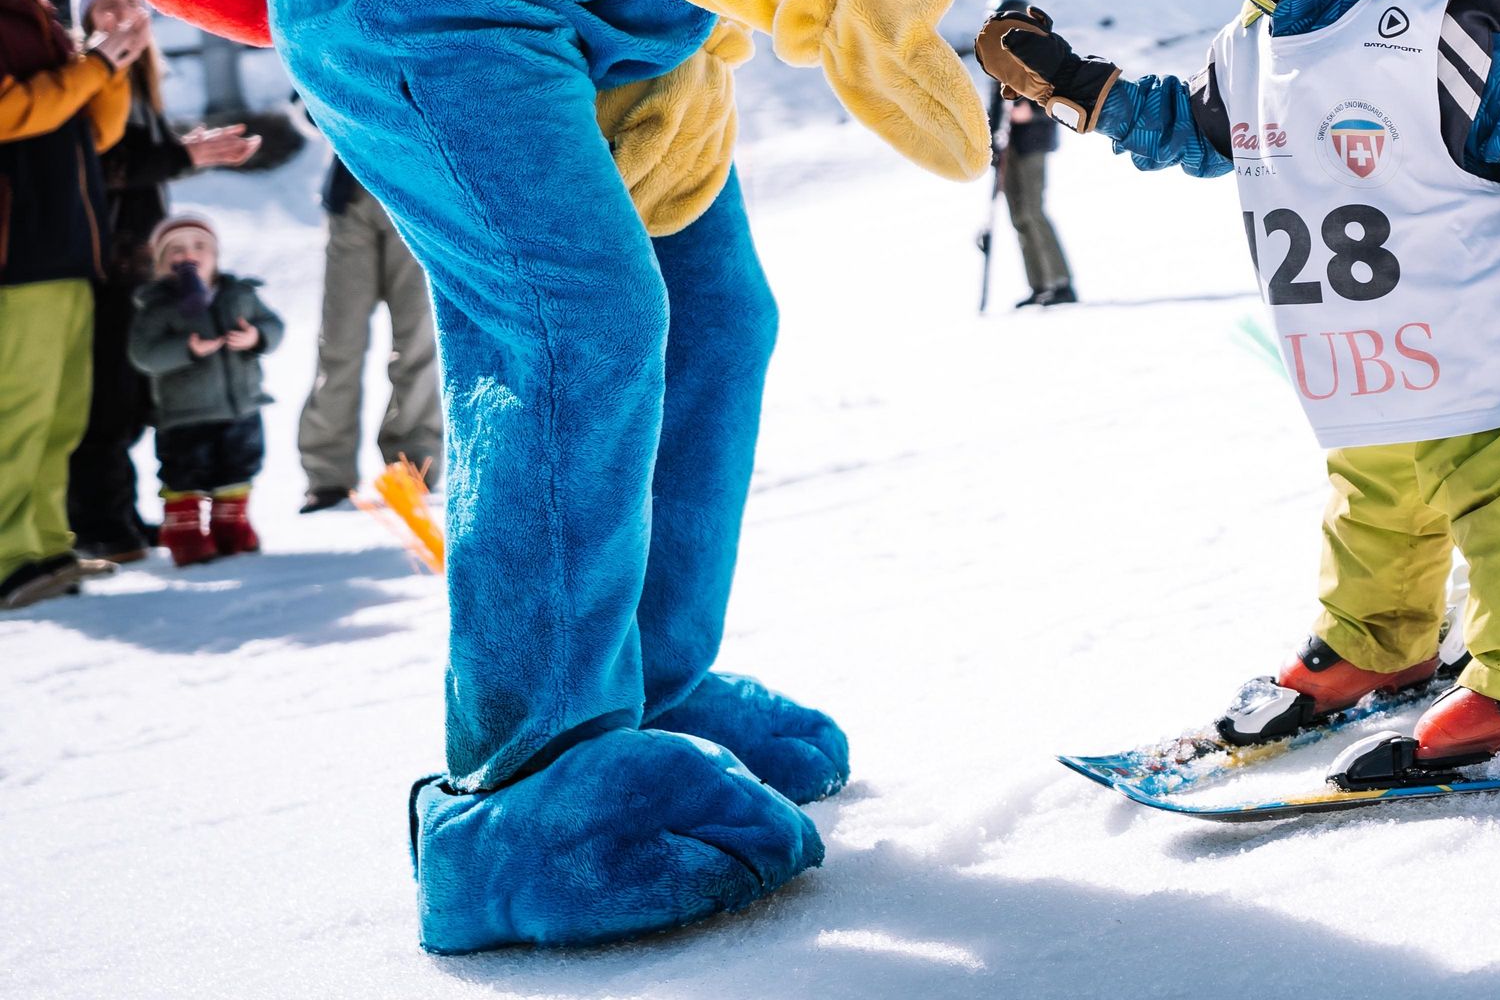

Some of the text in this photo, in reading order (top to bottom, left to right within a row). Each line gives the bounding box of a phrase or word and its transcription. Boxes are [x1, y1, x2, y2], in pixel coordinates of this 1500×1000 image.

[1364, 42, 1423, 54] DATASPORT
[1317, 121, 1330, 141] SWISS
[1344, 101, 1383, 119] SNOWBOARD
[1381, 116, 1400, 141] SCHOOL
[1284, 322, 1441, 401] UBS
